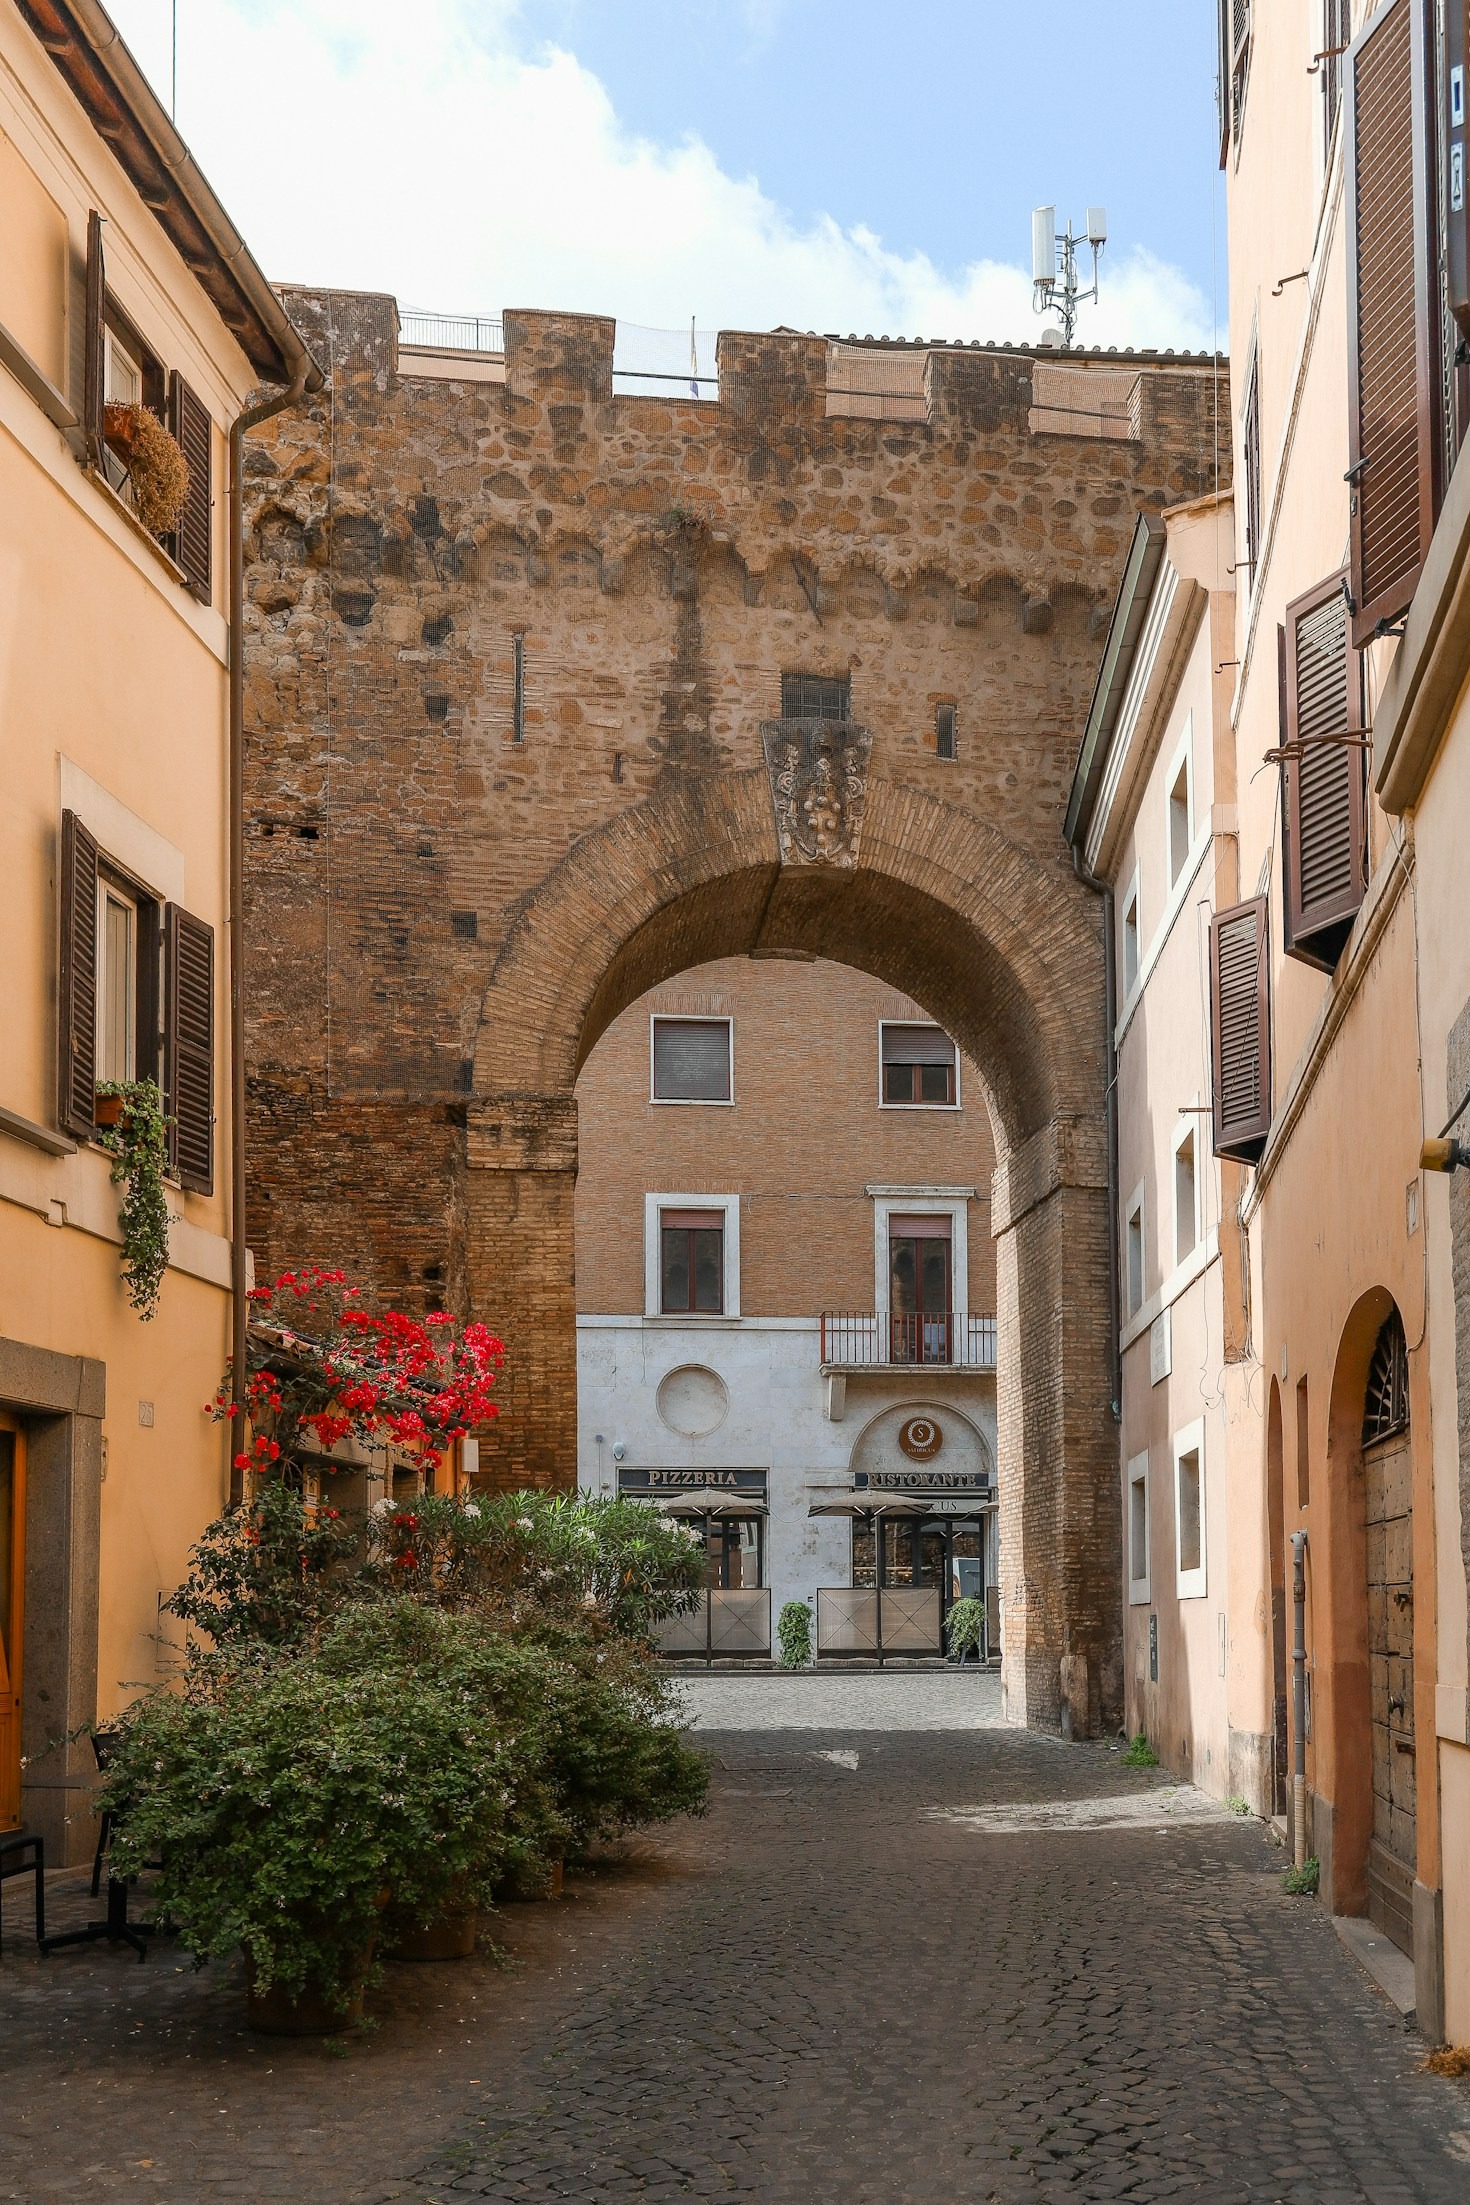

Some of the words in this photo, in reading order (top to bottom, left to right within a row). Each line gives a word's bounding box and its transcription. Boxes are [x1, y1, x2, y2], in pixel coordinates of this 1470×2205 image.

[917, 1427, 924, 1438] S
[648, 1471, 738, 1485] PIZZERIA
[867, 1473, 977, 1486] RISTORANTE
